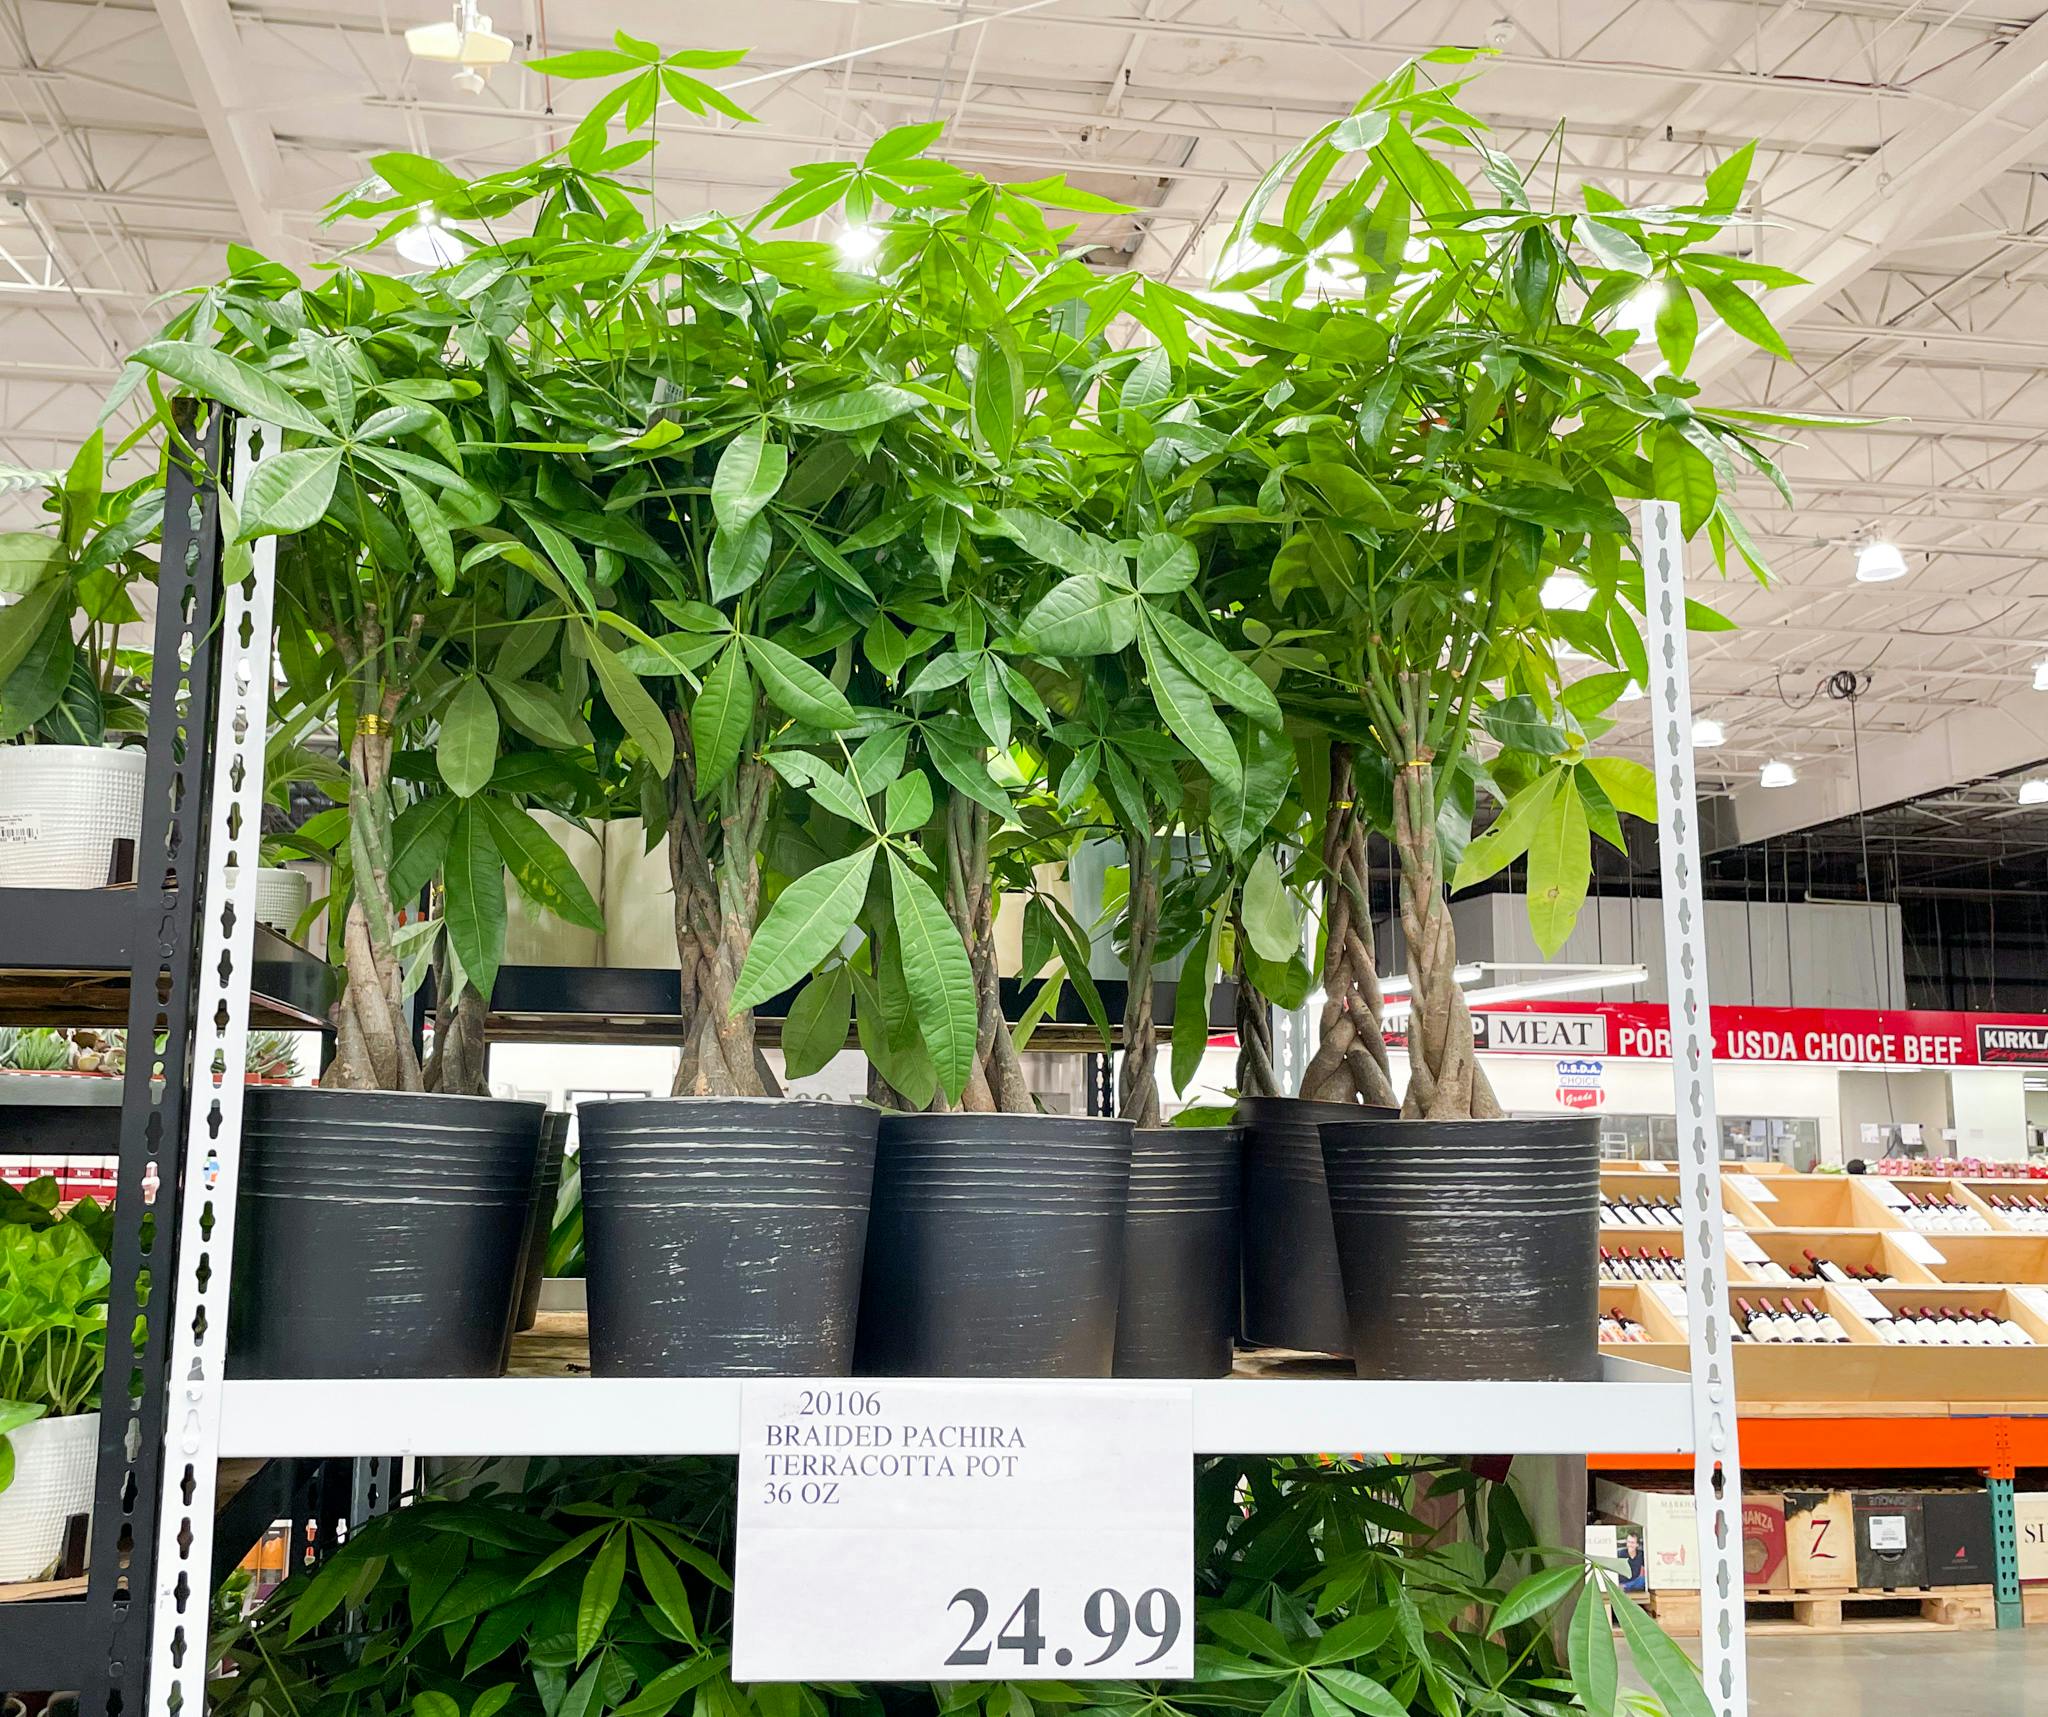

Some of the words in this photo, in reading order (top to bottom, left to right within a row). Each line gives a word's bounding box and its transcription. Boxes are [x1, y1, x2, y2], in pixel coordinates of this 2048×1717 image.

[1498, 1020, 1593, 1046] MEAT
[1619, 1028, 1672, 1057] POR
[1727, 1030, 1798, 1060] USDA
[1804, 1031, 1897, 1062] CHOICE
[1903, 1035, 1963, 1064] BEEF
[1559, 1063, 1601, 1075] U.S.D.A.
[1560, 1076, 1600, 1086] CHOICE
[1565, 1092, 1593, 1106] Grade
[800, 1390, 882, 1417] 20106
[766, 1425, 893, 1448] BRAIDED
[902, 1425, 1026, 1449] PACHIRA
[765, 1454, 955, 1477] TERRACOTTA
[966, 1455, 1019, 1478] POT
[763, 1482, 792, 1505] 36
[801, 1482, 840, 1505] OZ
[2024, 1522, 2048, 1544] SI
[943, 1587, 1182, 1667] 24.99
